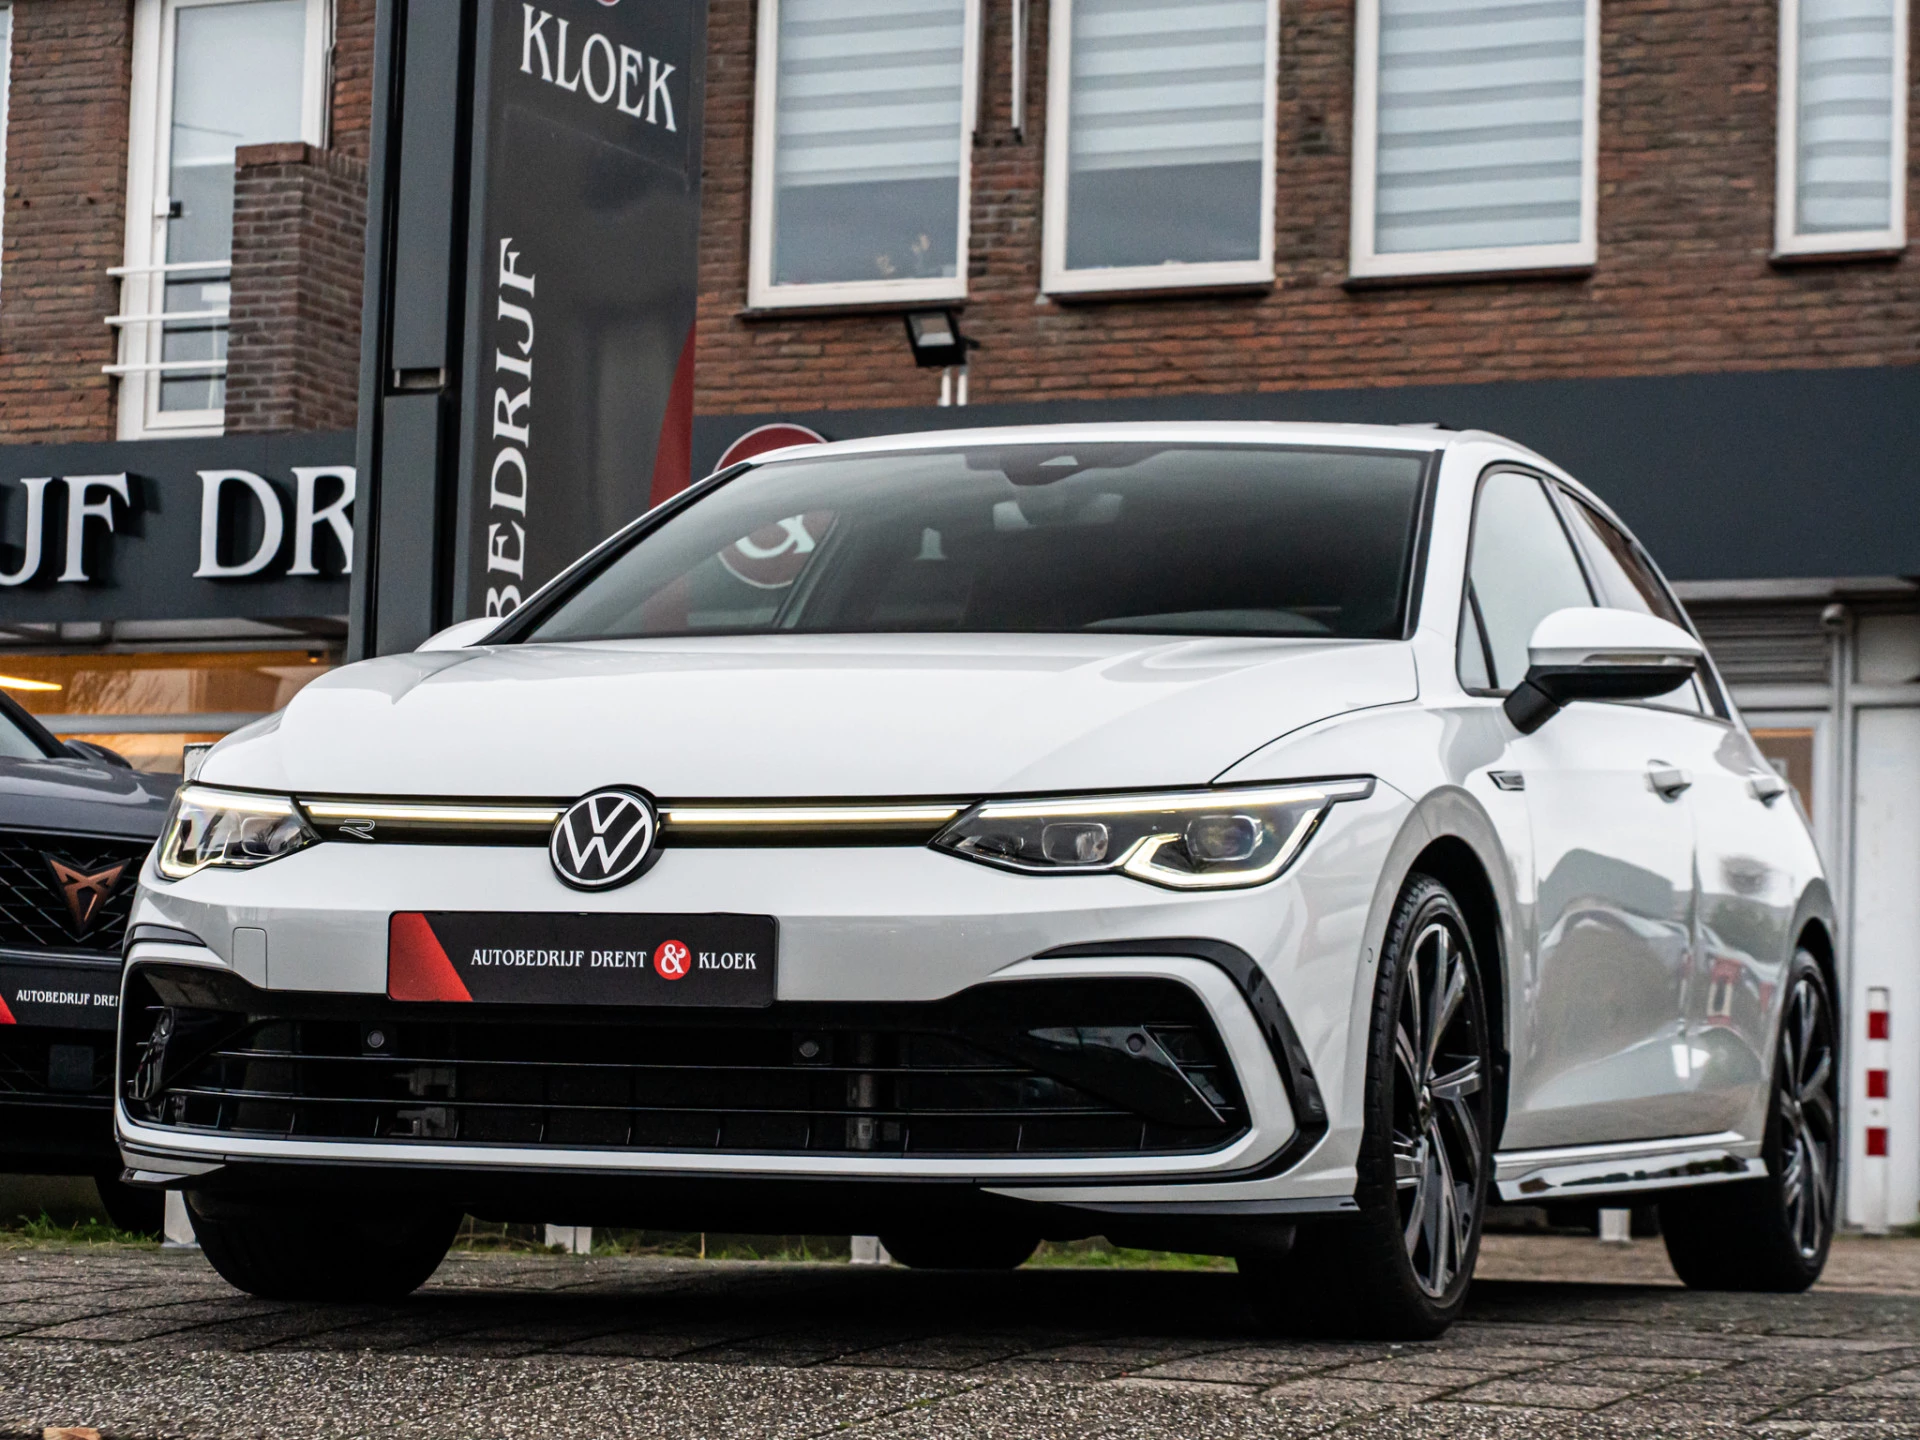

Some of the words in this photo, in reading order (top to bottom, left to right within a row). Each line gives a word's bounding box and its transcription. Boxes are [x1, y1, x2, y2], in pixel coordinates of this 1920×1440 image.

[519, 2, 677, 133] KLOEK
[470, 949, 584, 967] AUTOBEDRIJF
[590, 950, 647, 968] DRENT
[660, 943, 687, 974] &
[698, 951, 757, 969] KLOEK
[16, 989, 90, 1005] AUTOBEDRIJF
